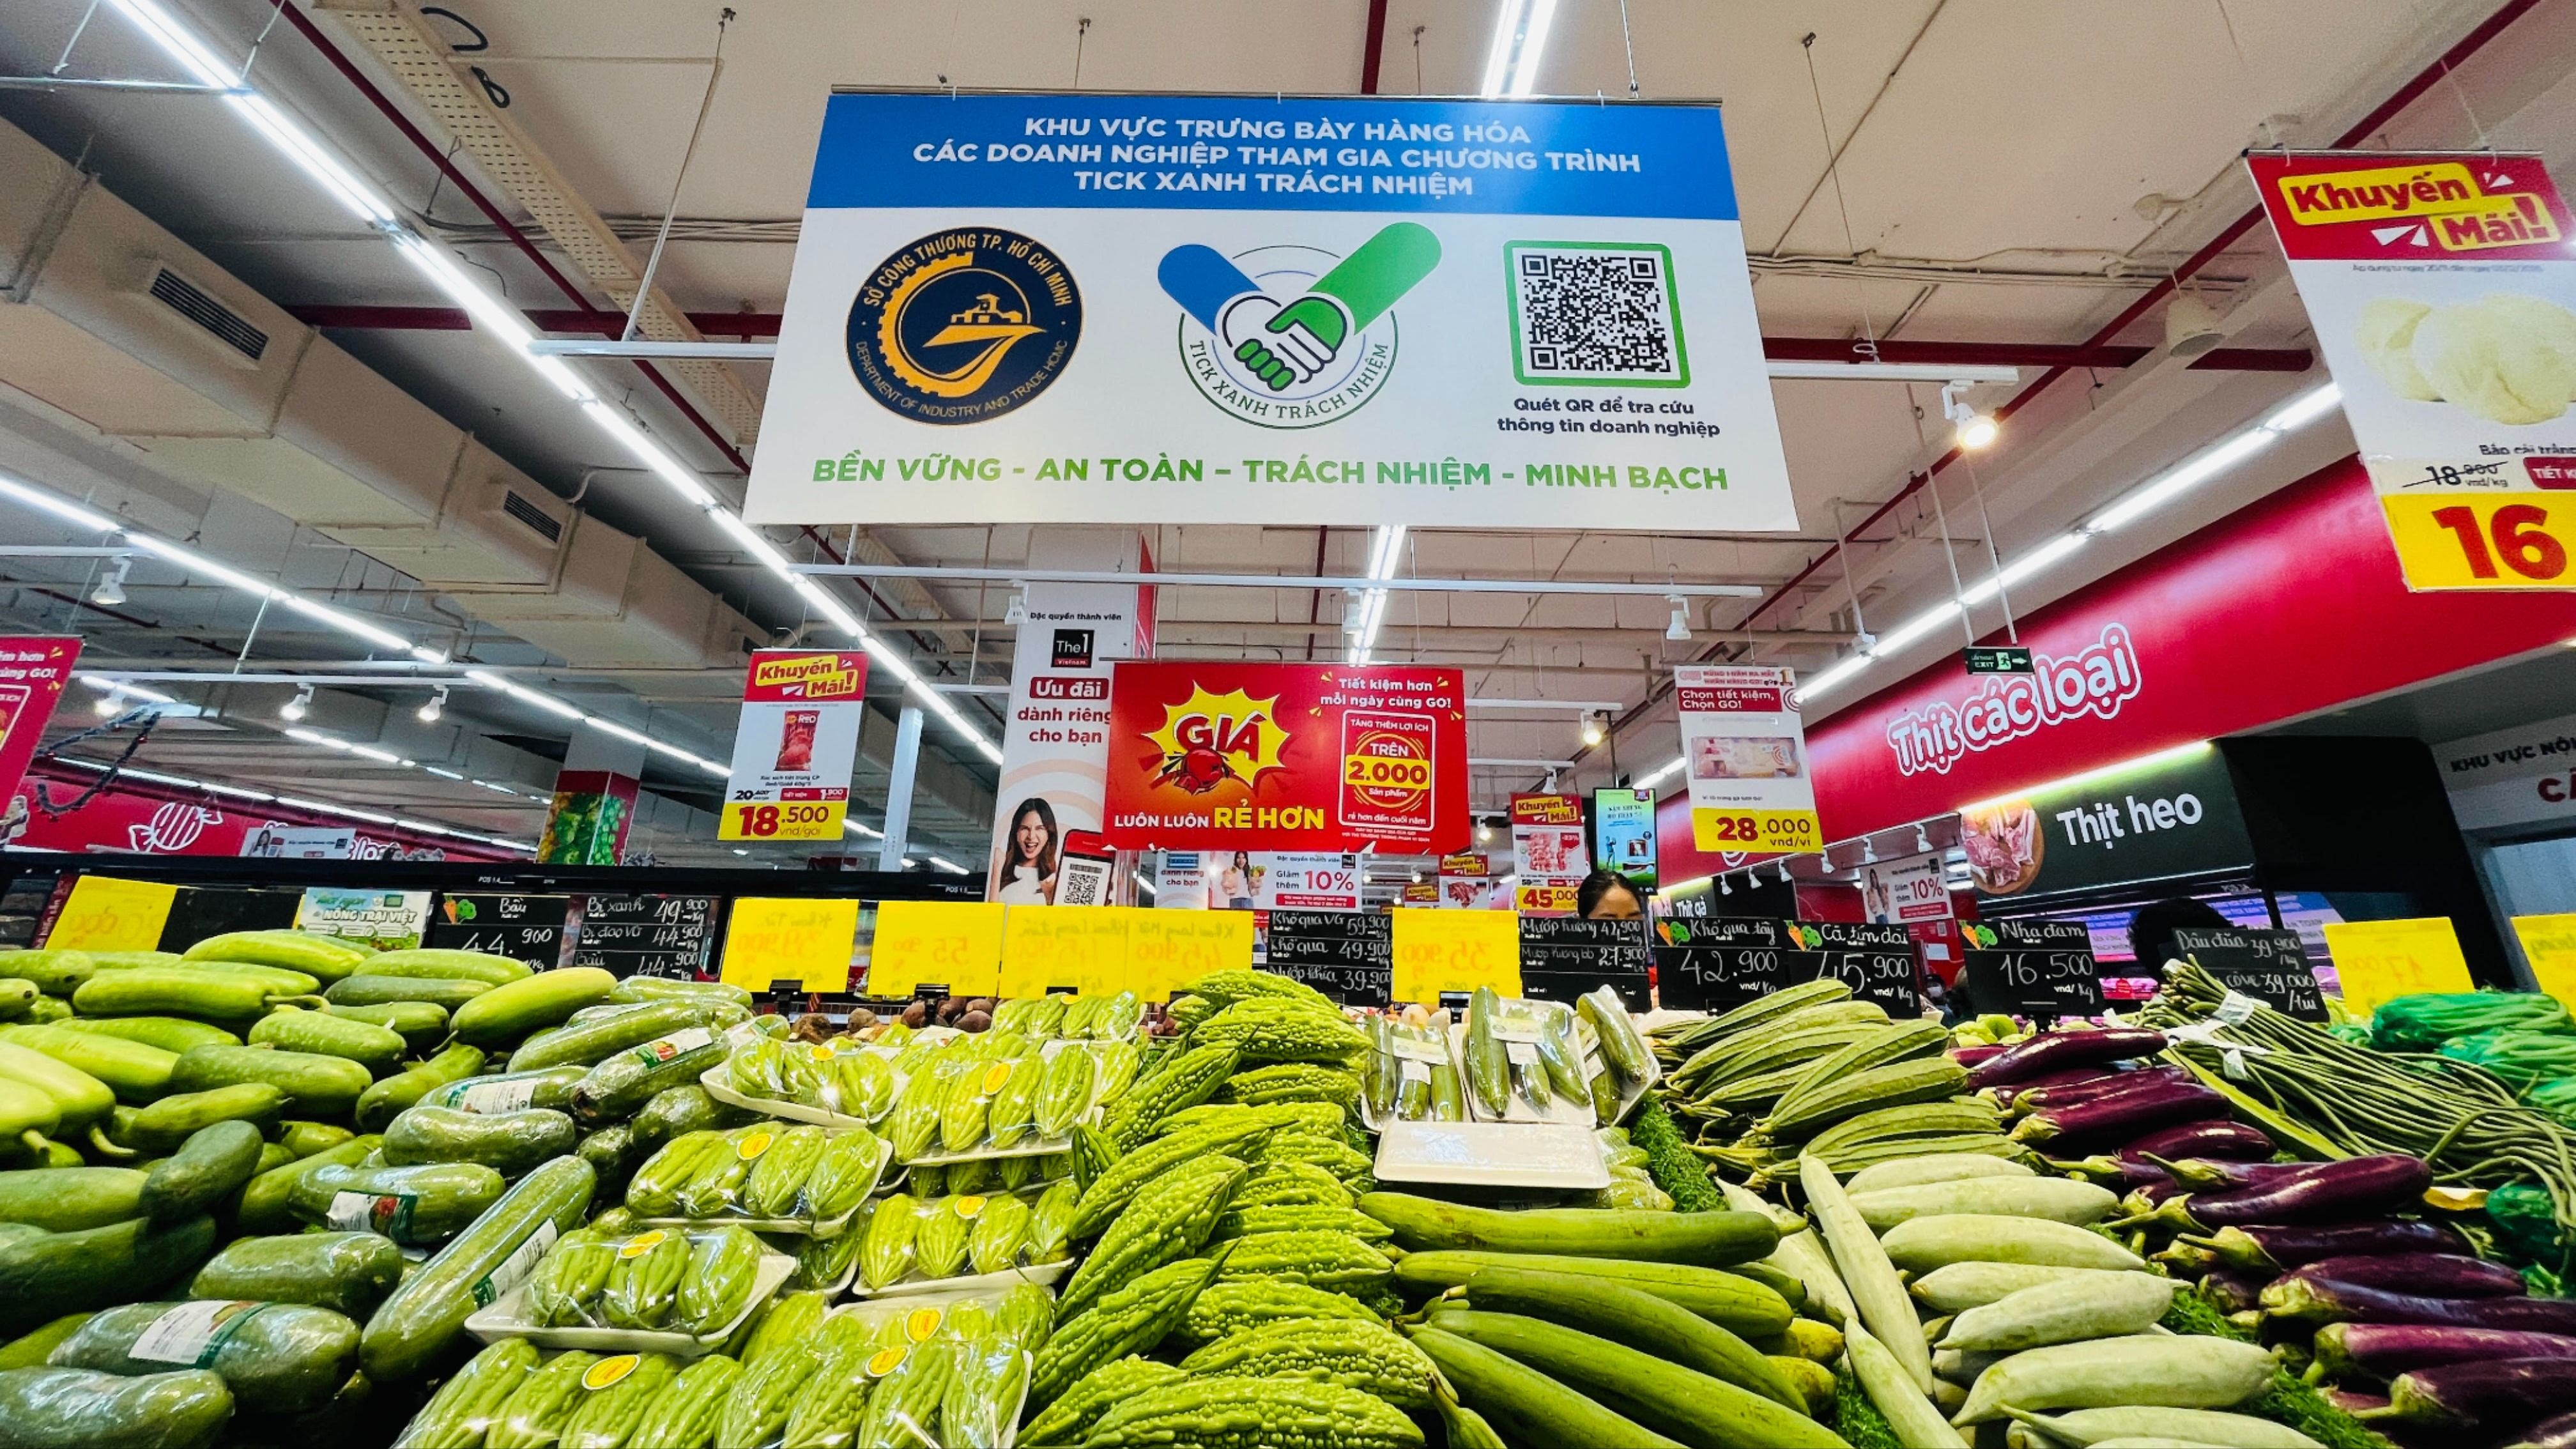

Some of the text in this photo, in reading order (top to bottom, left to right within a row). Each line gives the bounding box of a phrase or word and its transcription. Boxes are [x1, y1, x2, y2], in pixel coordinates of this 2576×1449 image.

[1025, 116, 1531, 143] KHU VỰC TRƯNG BÀY HÀNG HÓA
[912, 139, 1640, 172] CÁC DOANH NGHIỆP THAM GIA CHƯƠNG TRÌNH
[1074, 169, 1473, 199] TICK XANH TRÁCH NHIỆM
[2290, 171, 2471, 213] Khuyến
[863, 233, 1073, 307] SỞ CÔNG THƯƠNG TP. HỒ CHÍ MINH
[855, 340, 1068, 417] DEPARTMENT OF INDUSTRY AND TRADE HCMC
[1189, 340, 1388, 418] TICK XANH TRÁCH NHIỆM
[1514, 395, 1694, 415] Quét QR để tra cứu
[1498, 417, 1721, 438] thông tin doanh nghiệp
[812, 449, 1728, 496] BỀN VỮNG AN TOÀN TRÁCH NHIỆM MINH BẠCH
[2431, 504, 2567, 580] 16
[29, 668, 57, 678] GO!
[759, 659, 831, 680] Khuyến
[1036, 679, 1101, 697] Ưu đãi
[1338, 677, 1432, 692] Tiết kiệm hơn
[1682, 689, 1775, 701] Chọn tiết kiệm,
[1320, 692, 1452, 709] mỗi ngày cùng GO!
[1682, 700, 1742, 710] Chọn GO!
[1889, 633, 2133, 768] Thịt các loại
[1017, 707, 1062, 721] dành
[1029, 728, 1101, 746] cho bạn
[1174, 710, 1267, 763] GIÁ
[1370, 742, 1408, 756] TRÊN
[1348, 760, 1428, 785] 2.000
[2450, 755, 2490, 772] KHU
[739, 806, 829, 836] 18.500
[1114, 799, 1324, 829] LUÔN LUÔN RẺ HƠN
[2056, 793, 2203, 849] Thịt heo
[1716, 816, 1811, 841] 28.000
[1305, 871, 1354, 891] 10%
[1910, 877, 1943, 899] 10%
[323, 906, 417, 924] NÔNG TRẠI VIỆT
[500, 898, 526, 913] Bầu
[608, 897, 645, 912] xanh
[1680, 949, 1778, 985] 42.900
[2000, 953, 2093, 986] 16.500
